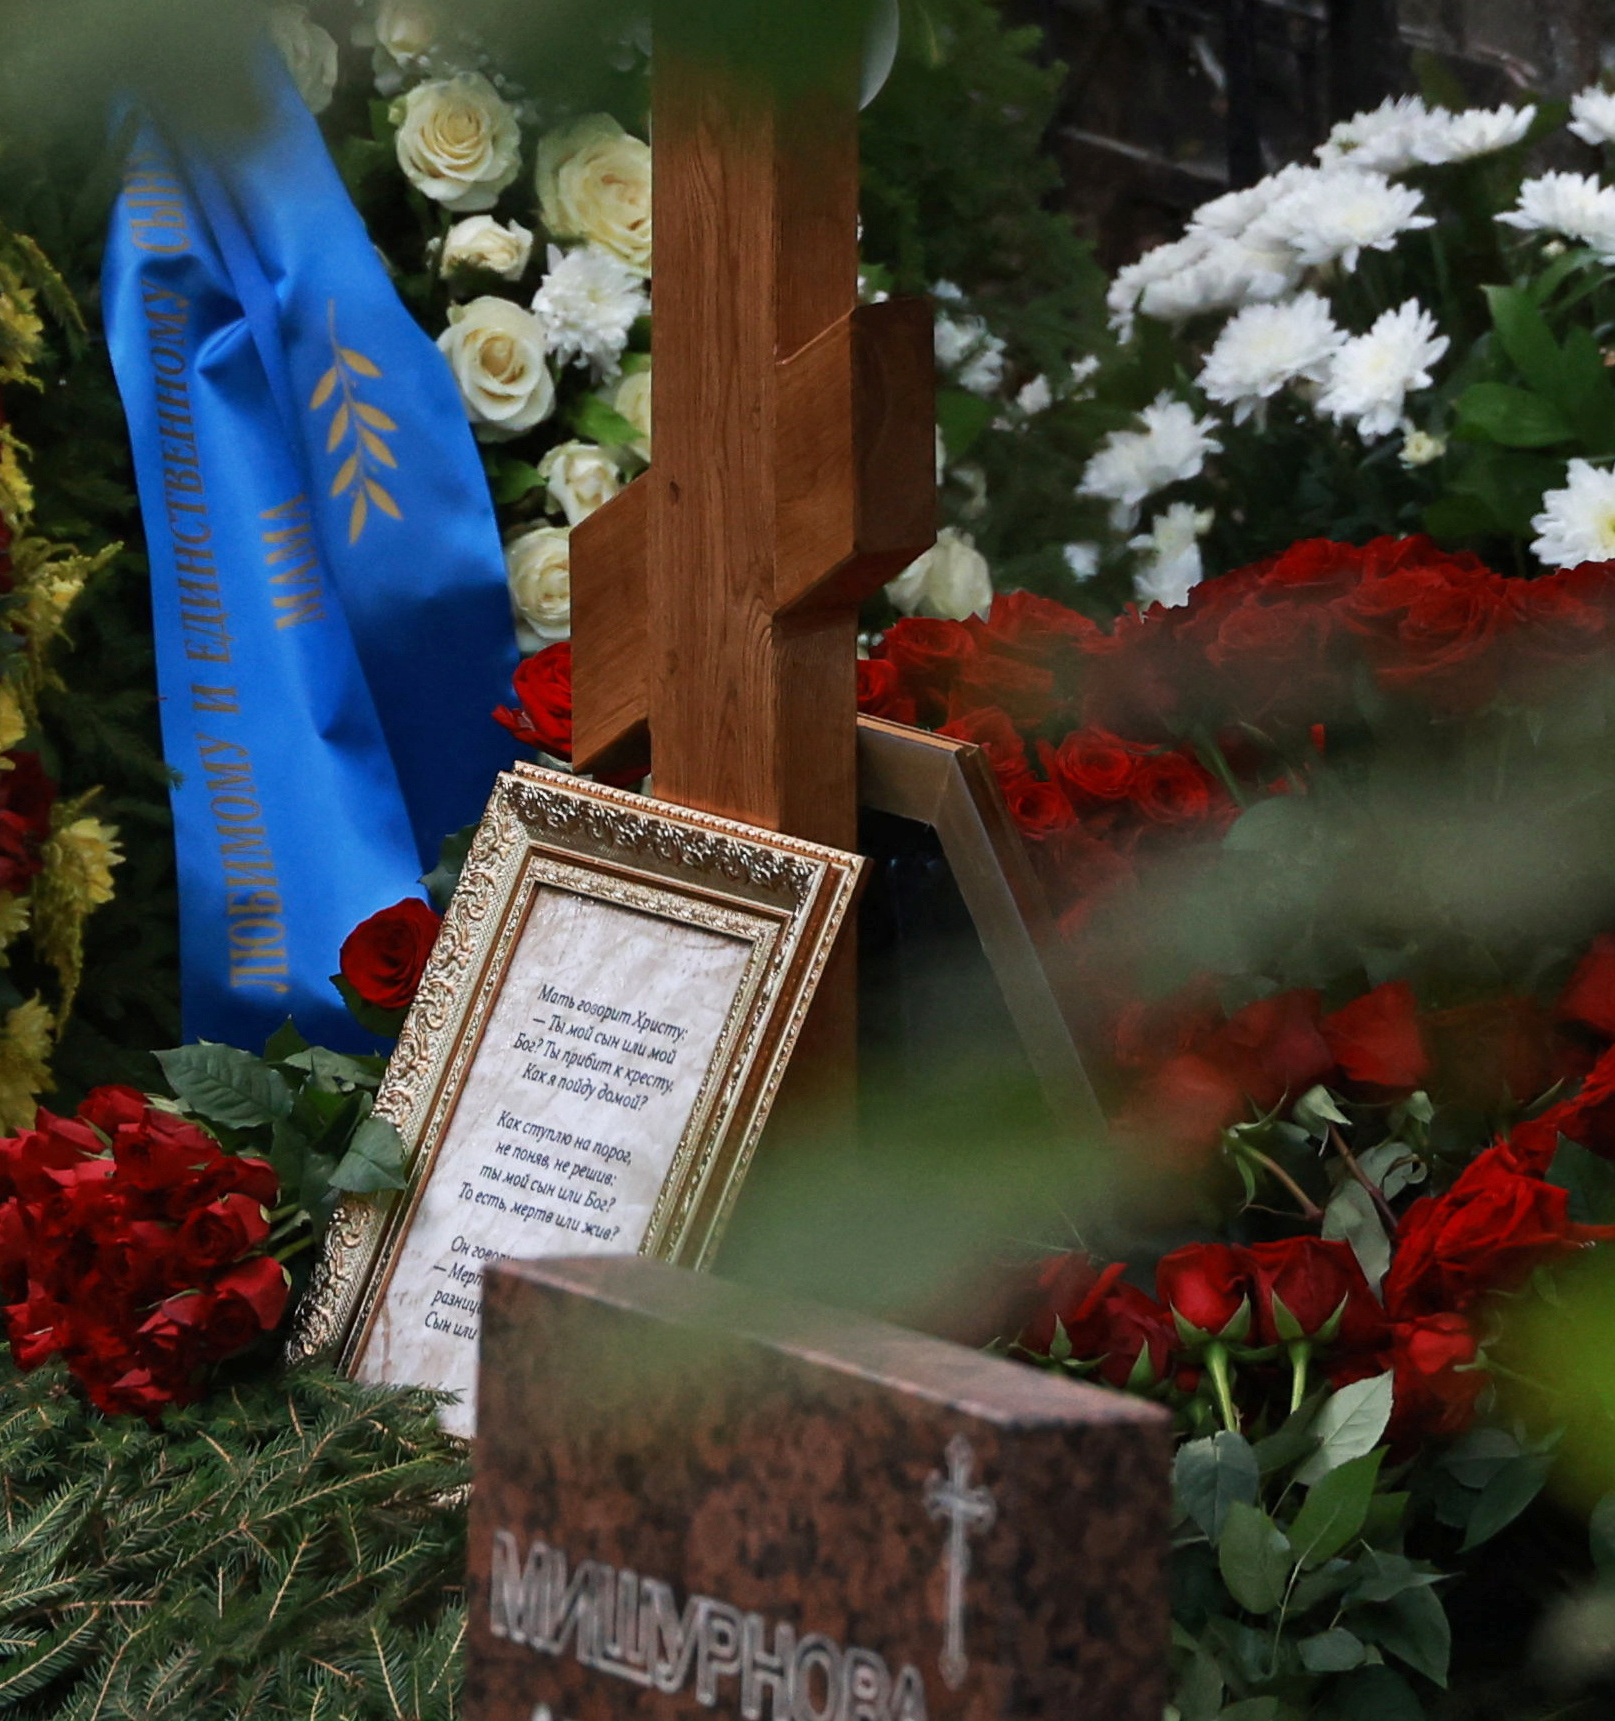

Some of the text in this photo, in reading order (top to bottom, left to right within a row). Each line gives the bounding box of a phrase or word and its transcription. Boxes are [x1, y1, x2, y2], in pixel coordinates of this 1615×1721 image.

[141, 280, 234, 664] ЕДИНСТВЕННОМУ
[259, 492, 327, 630] МАМА
[191, 684, 240, 714] И
[196, 732, 290, 994] ЛЮБИМОМУ
[537, 984, 689, 1044] Мать говорит Христу:
[513, 1032, 544, 1053] Бог?
[543, 1040, 561, 1060] Ты
[561, 1050, 613, 1076] прибит
[613, 1064, 624, 1078] к
[548, 1014, 565, 1034] Ты
[566, 1023, 593, 1042] мой
[594, 1033, 620, 1049] сын
[621, 1040, 646, 1057] или
[647, 1049, 677, 1065] мой
[521, 1062, 649, 1111] Как я пойду домой?
[496, 1110, 633, 1166] Как ступлю на порог,
[479, 1165, 617, 1213] ты мой сын или Бог?
[495, 1141, 618, 1187] не поняв, не решив:
[458, 1181, 621, 1242] То есть, мертв или жив?
[450, 1235, 471, 1256] Он
[424, 1311, 478, 1340] Сын или
